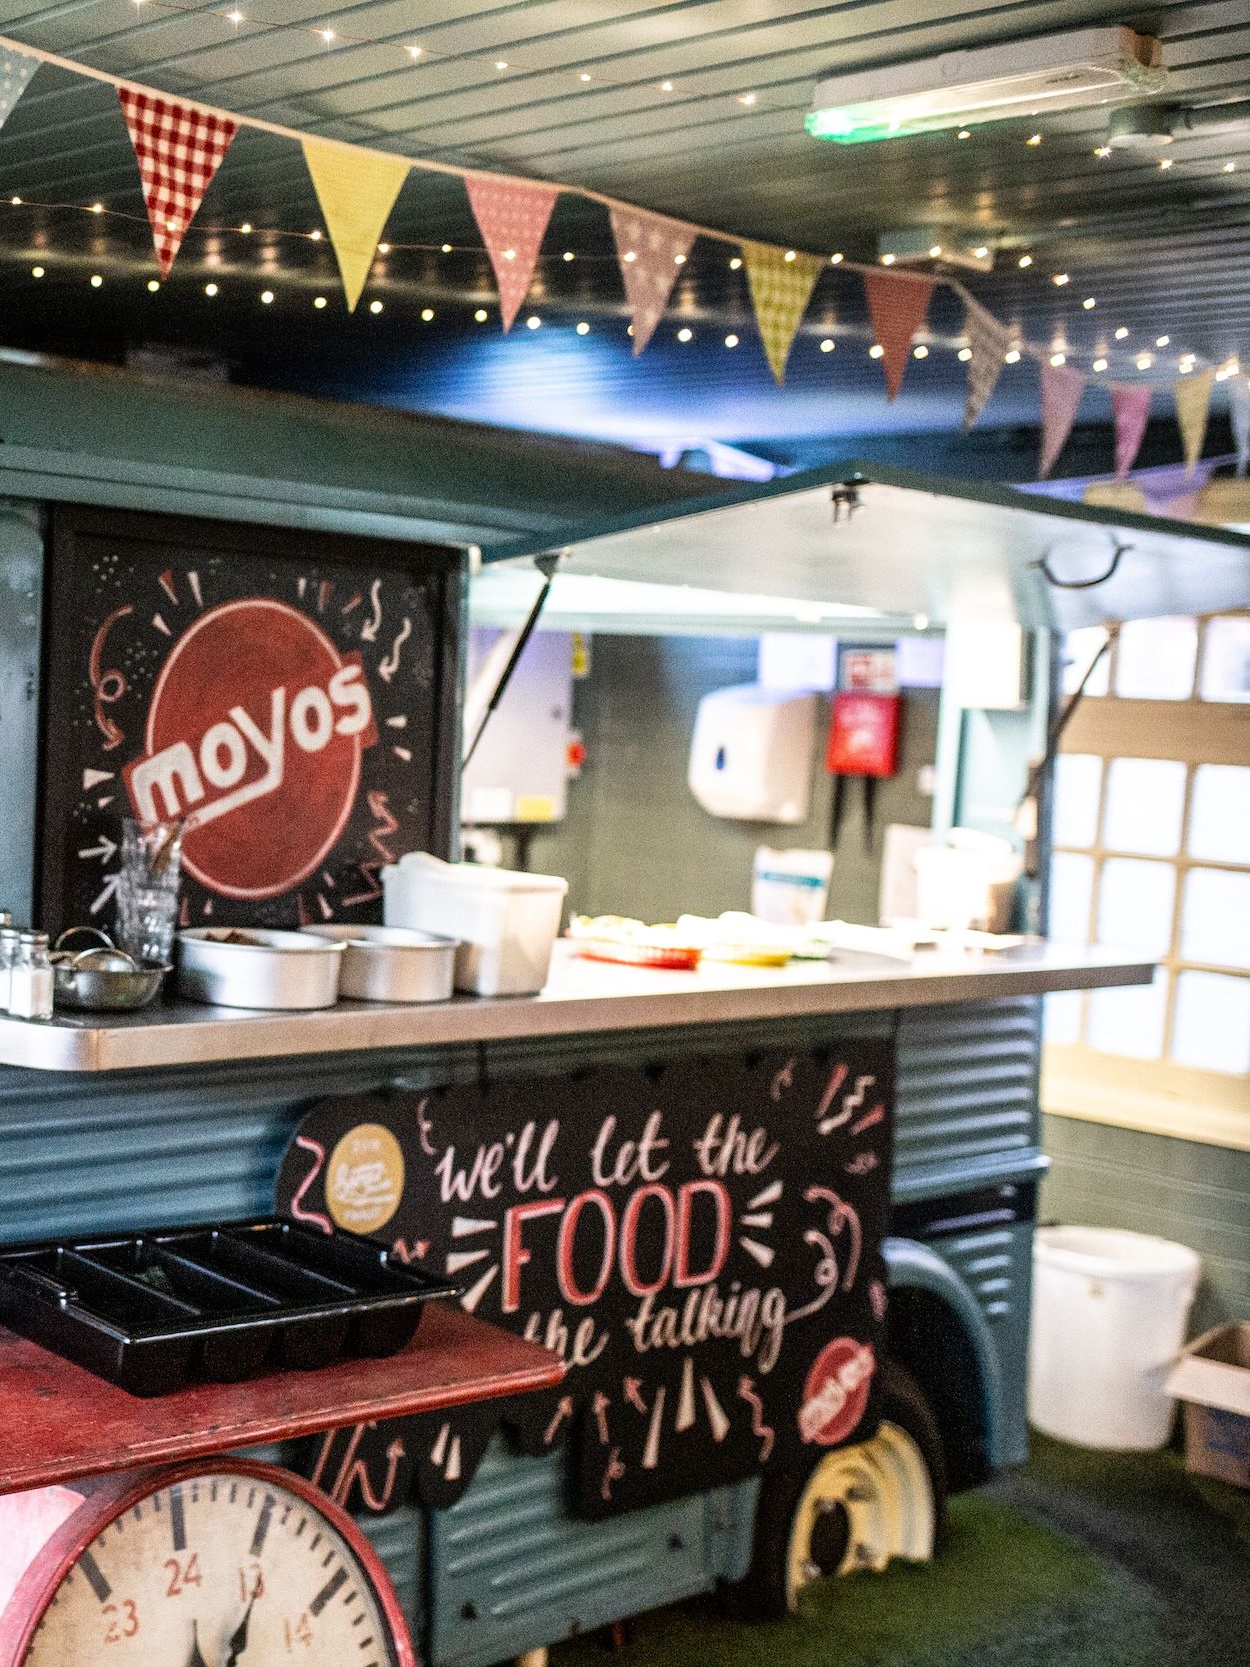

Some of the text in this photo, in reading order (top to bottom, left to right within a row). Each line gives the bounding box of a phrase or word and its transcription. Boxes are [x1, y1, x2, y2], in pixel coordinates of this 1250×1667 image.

[130, 663, 373, 833] moyos
[434, 1118, 560, 1203] we'll
[590, 1110, 671, 1188] let
[693, 1111, 782, 1177] the
[502, 1179, 733, 1314] FOOD
[626, 1284, 786, 1375] talking
[163, 1552, 203, 1598] 24
[101, 1598, 140, 1644] 23
[282, 1611, 313, 1654] 14
